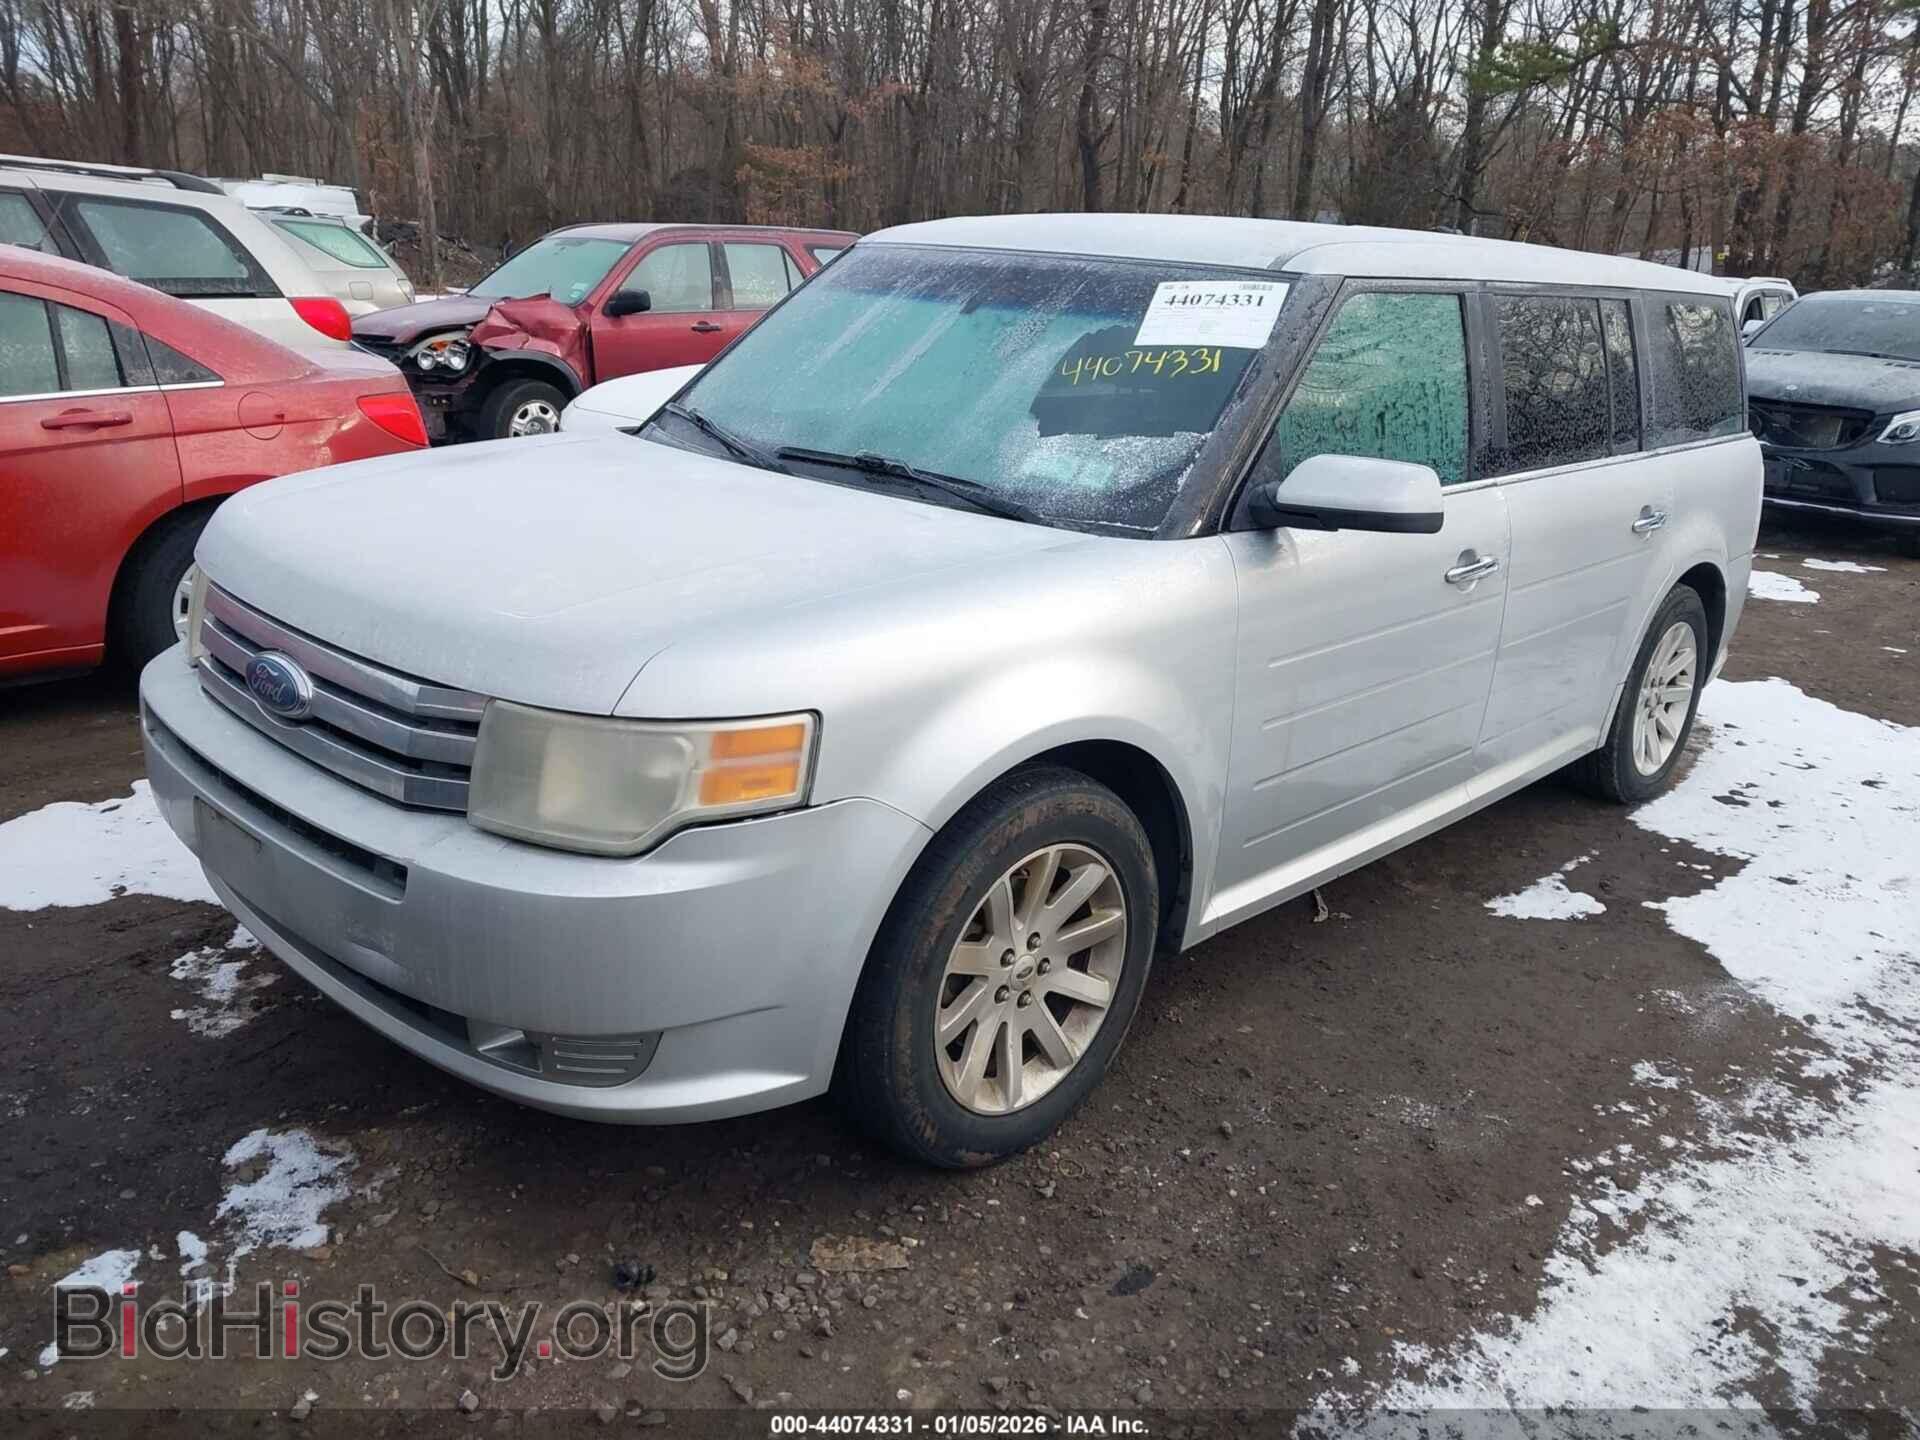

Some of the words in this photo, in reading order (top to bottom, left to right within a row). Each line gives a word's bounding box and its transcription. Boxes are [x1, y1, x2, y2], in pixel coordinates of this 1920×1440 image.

[1164, 294, 1264, 307] 44074331
[1062, 347, 1222, 386] 44074331
[251, 662, 288, 703] Ford
